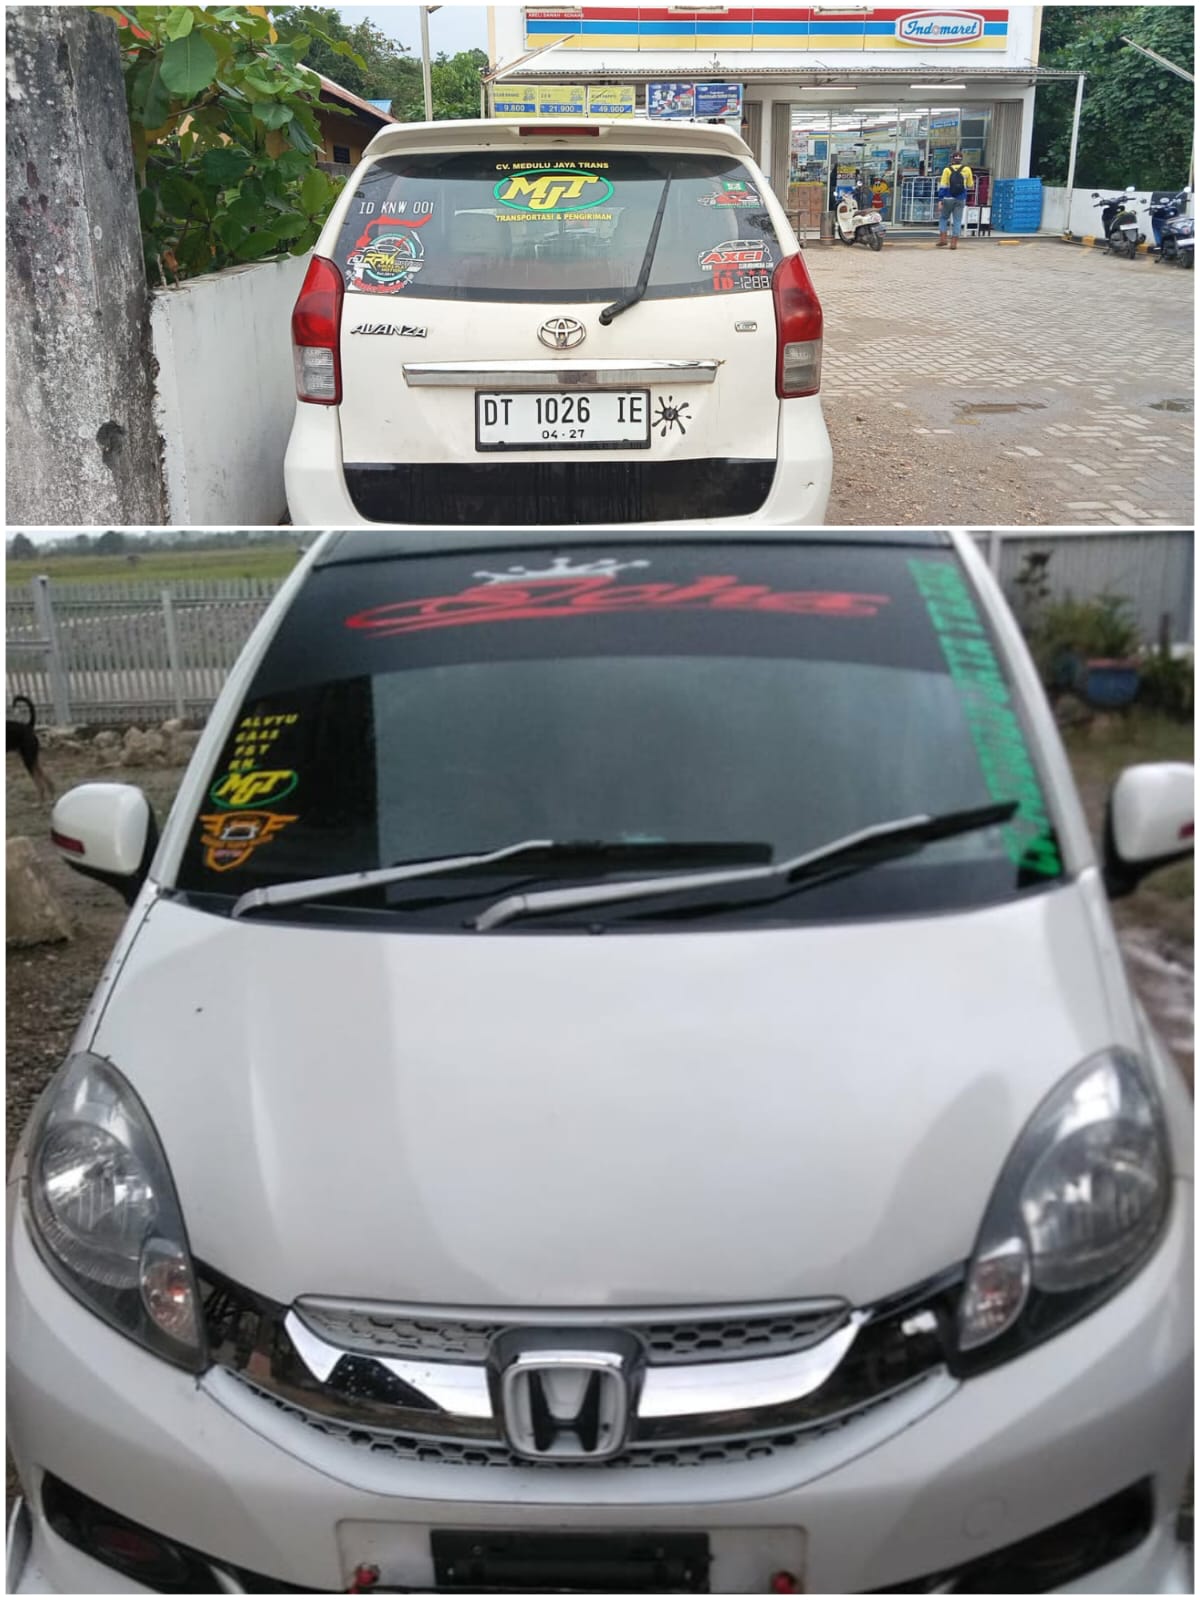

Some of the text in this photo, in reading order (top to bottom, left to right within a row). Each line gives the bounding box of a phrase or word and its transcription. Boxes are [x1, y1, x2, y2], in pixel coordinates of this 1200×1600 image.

[904, 20, 977, 35] Indomaret
[578, 161, 609, 169] TRANS
[500, 175, 600, 210] MJT
[359, 201, 434, 214] ID KNW 001
[496, 213, 555, 222] TRANSPORTASI
[563, 212, 613, 221] PENGIRIMAN
[350, 323, 428, 338] AVANZA
[484, 396, 643, 426] DT 1026 IE
